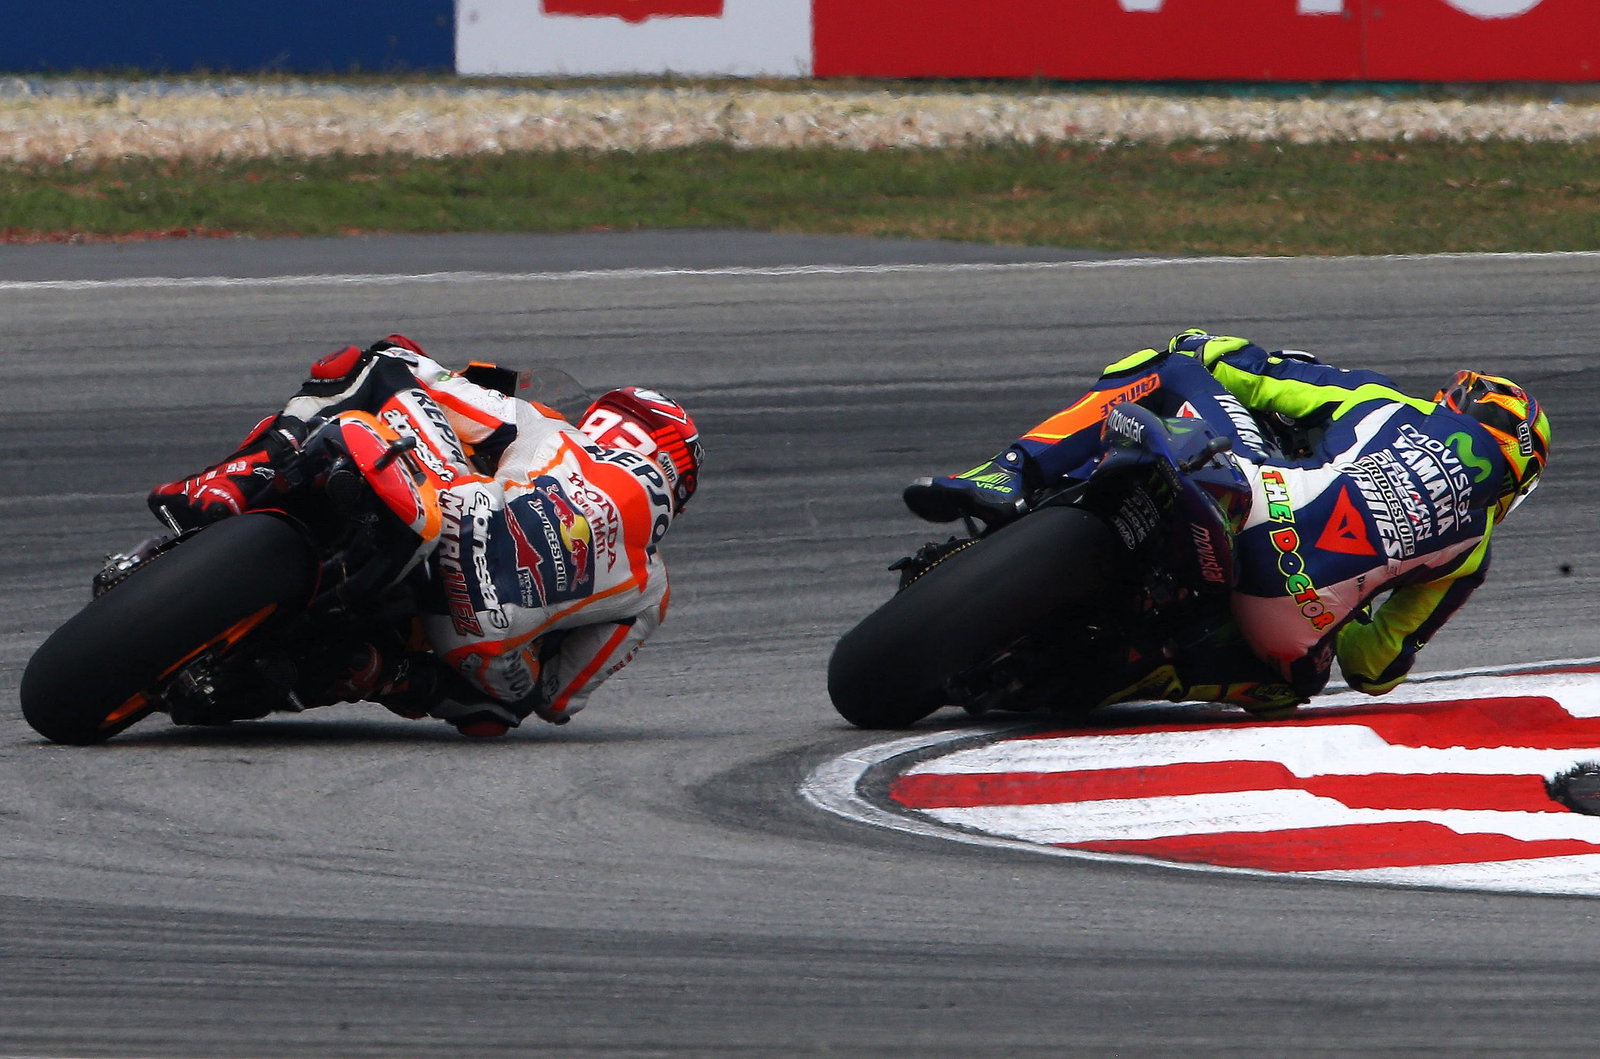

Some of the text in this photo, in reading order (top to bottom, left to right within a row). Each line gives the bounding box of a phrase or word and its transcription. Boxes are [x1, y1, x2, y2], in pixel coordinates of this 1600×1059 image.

[411, 389, 469, 467] REPS
[1107, 408, 1145, 444] movistar
[1401, 423, 1472, 524] movistar
[569, 472, 617, 573] HONDA
[976, 481, 1013, 494] VR46
[1261, 470, 1296, 524] THE
[1382, 449, 1433, 538] SEMAKIN
[1392, 435, 1455, 536] YAMAHA
[438, 491, 485, 637] MARQUEZ
[468, 491, 510, 629] alpinestars
[1269, 527, 1335, 632] DOCTOR
